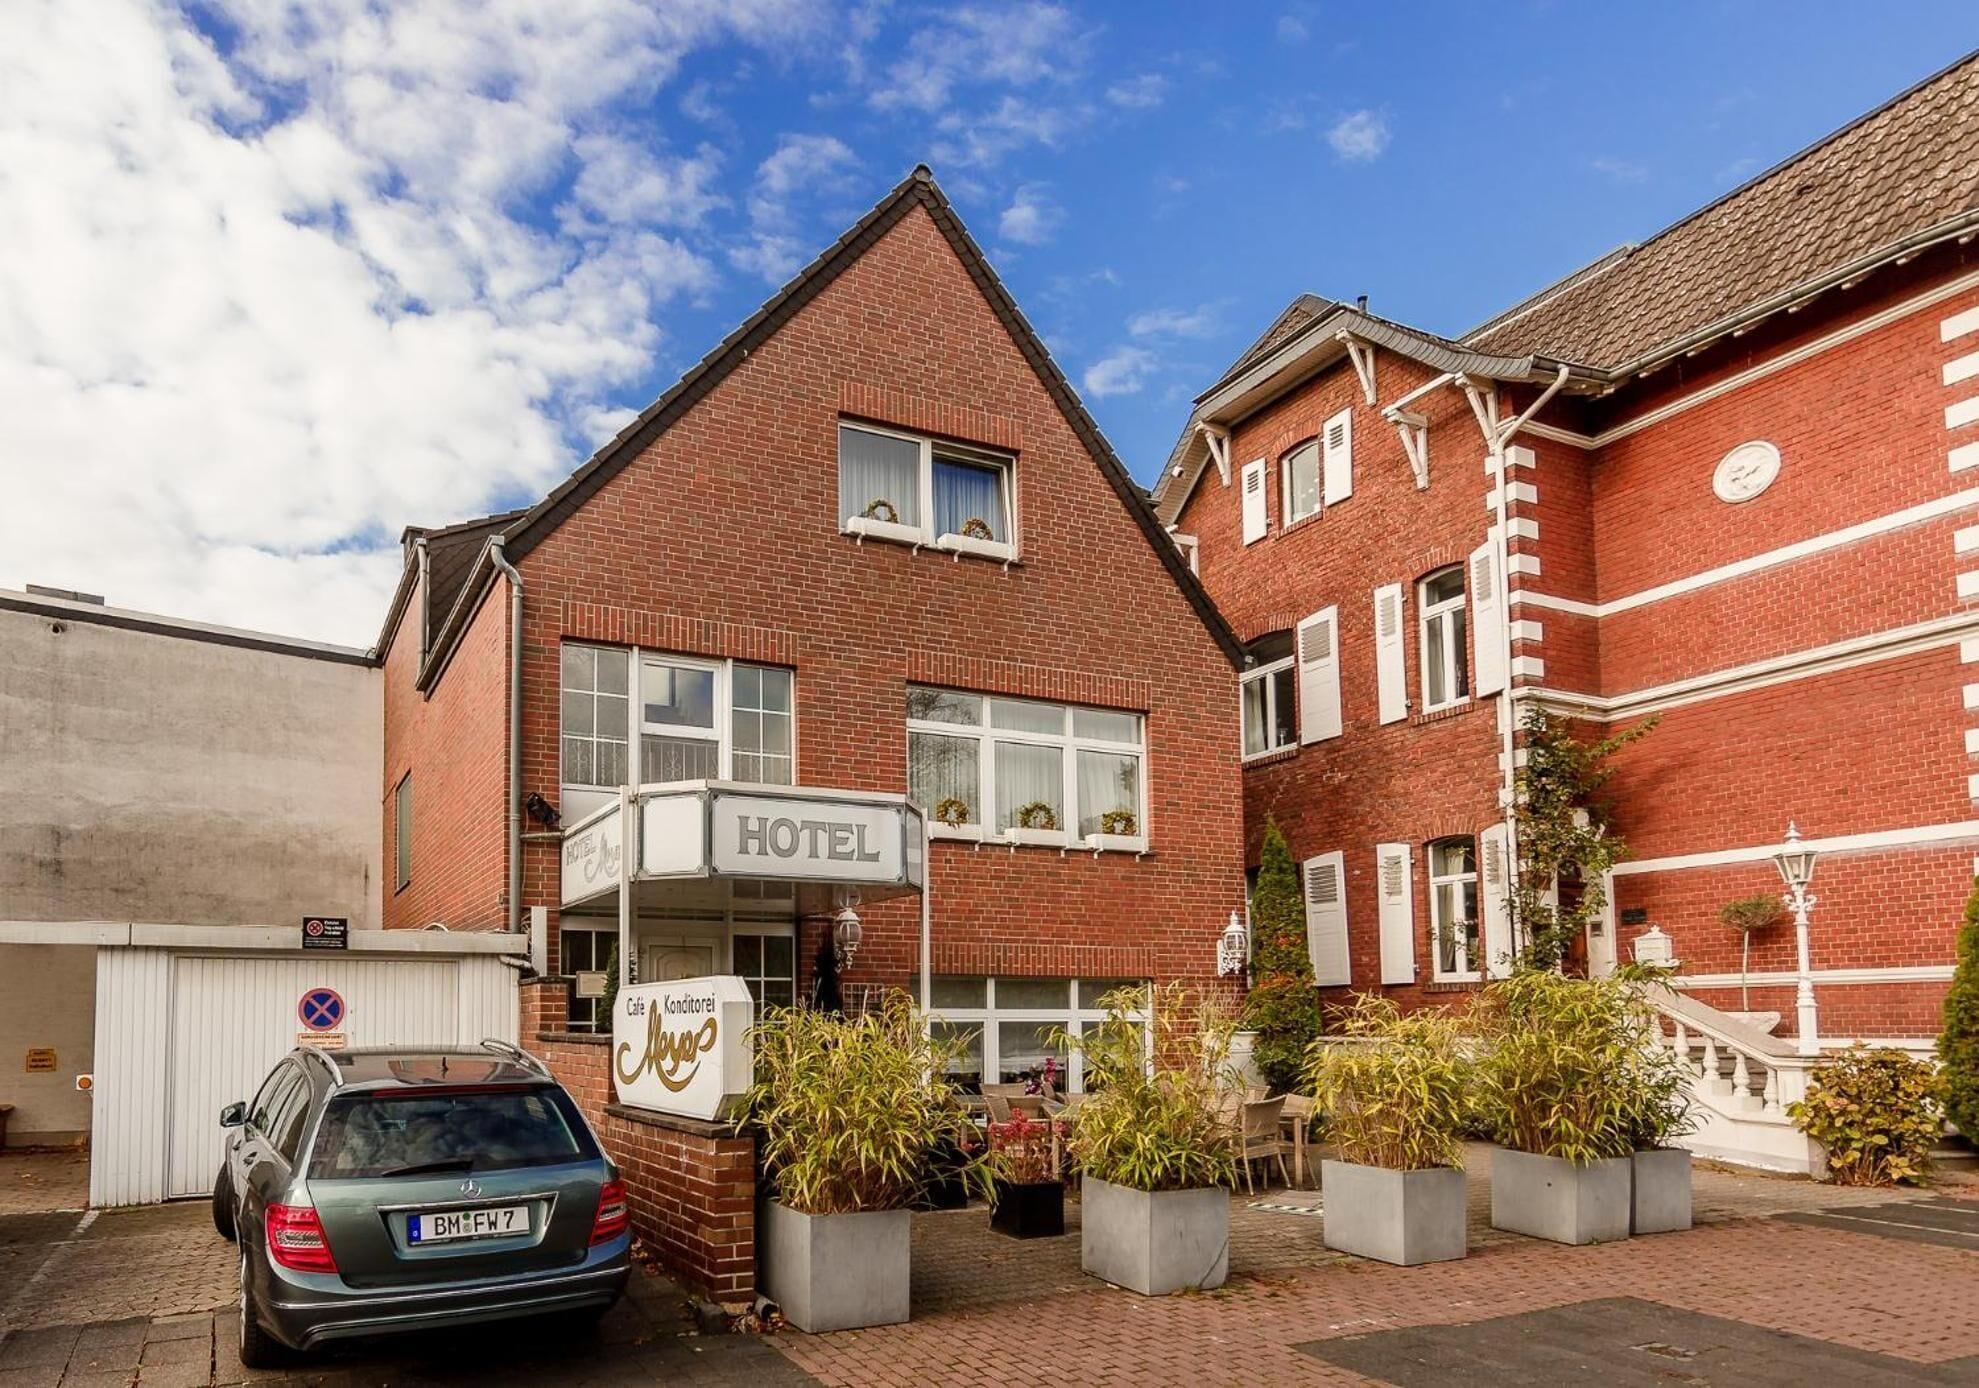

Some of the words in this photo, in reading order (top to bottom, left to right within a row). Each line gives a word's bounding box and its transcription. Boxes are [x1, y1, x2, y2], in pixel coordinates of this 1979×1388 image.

[565, 832, 597, 867] HOTEL
[737, 815, 881, 862] HOTEL
[626, 996, 645, 1016] Café
[664, 992, 715, 1015] Konditorei
[616, 998, 718, 1093] Meyer
[434, 1215, 461, 1236] BM
[473, 1211, 498, 1233] FW
[503, 1210, 514, 1229] 7
